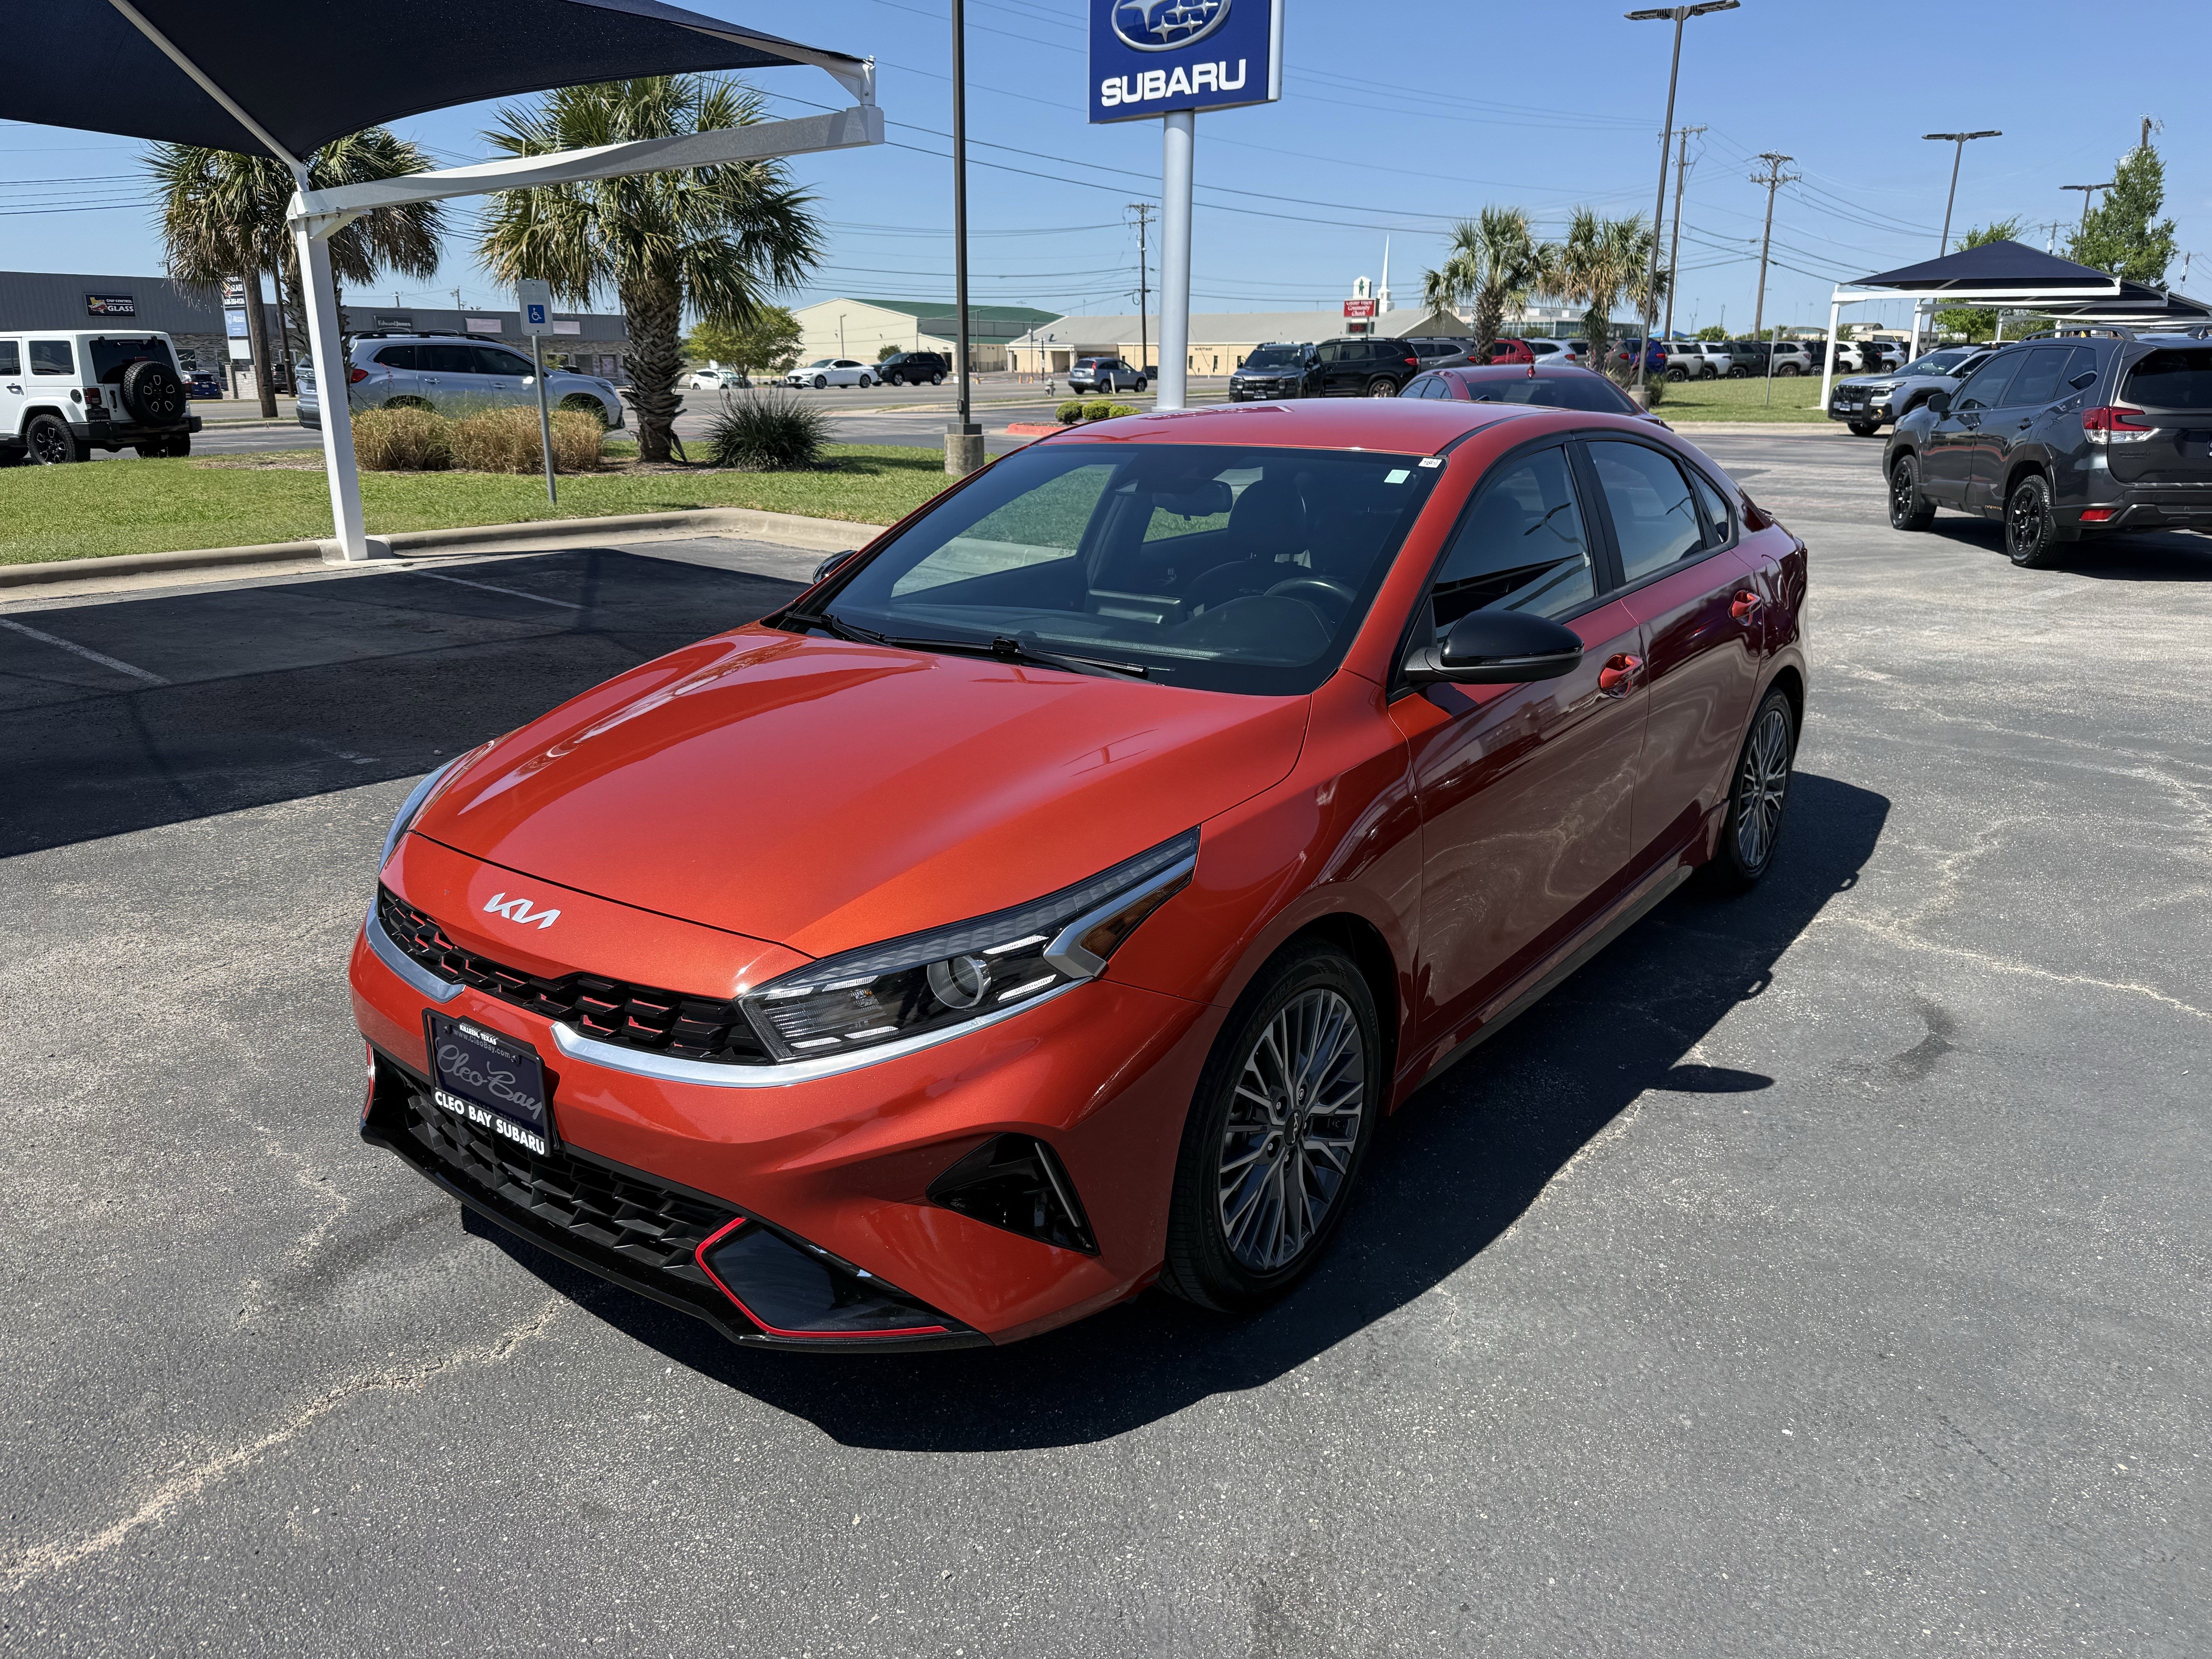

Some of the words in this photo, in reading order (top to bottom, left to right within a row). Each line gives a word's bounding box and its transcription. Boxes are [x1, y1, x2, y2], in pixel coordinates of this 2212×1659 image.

[1101, 59, 1247, 107] SUBARU
[484, 892, 561, 929] KIA
[460, 1024, 480, 1039] KILLEEN,
[480, 1033, 497, 1045] TEXAS
[435, 1037, 488, 1087] Cleo
[487, 1061, 542, 1120] Bay
[435, 1091, 465, 1115] CLEO
[469, 1106, 493, 1127] BAY
[496, 1119, 545, 1155] SUBARU
